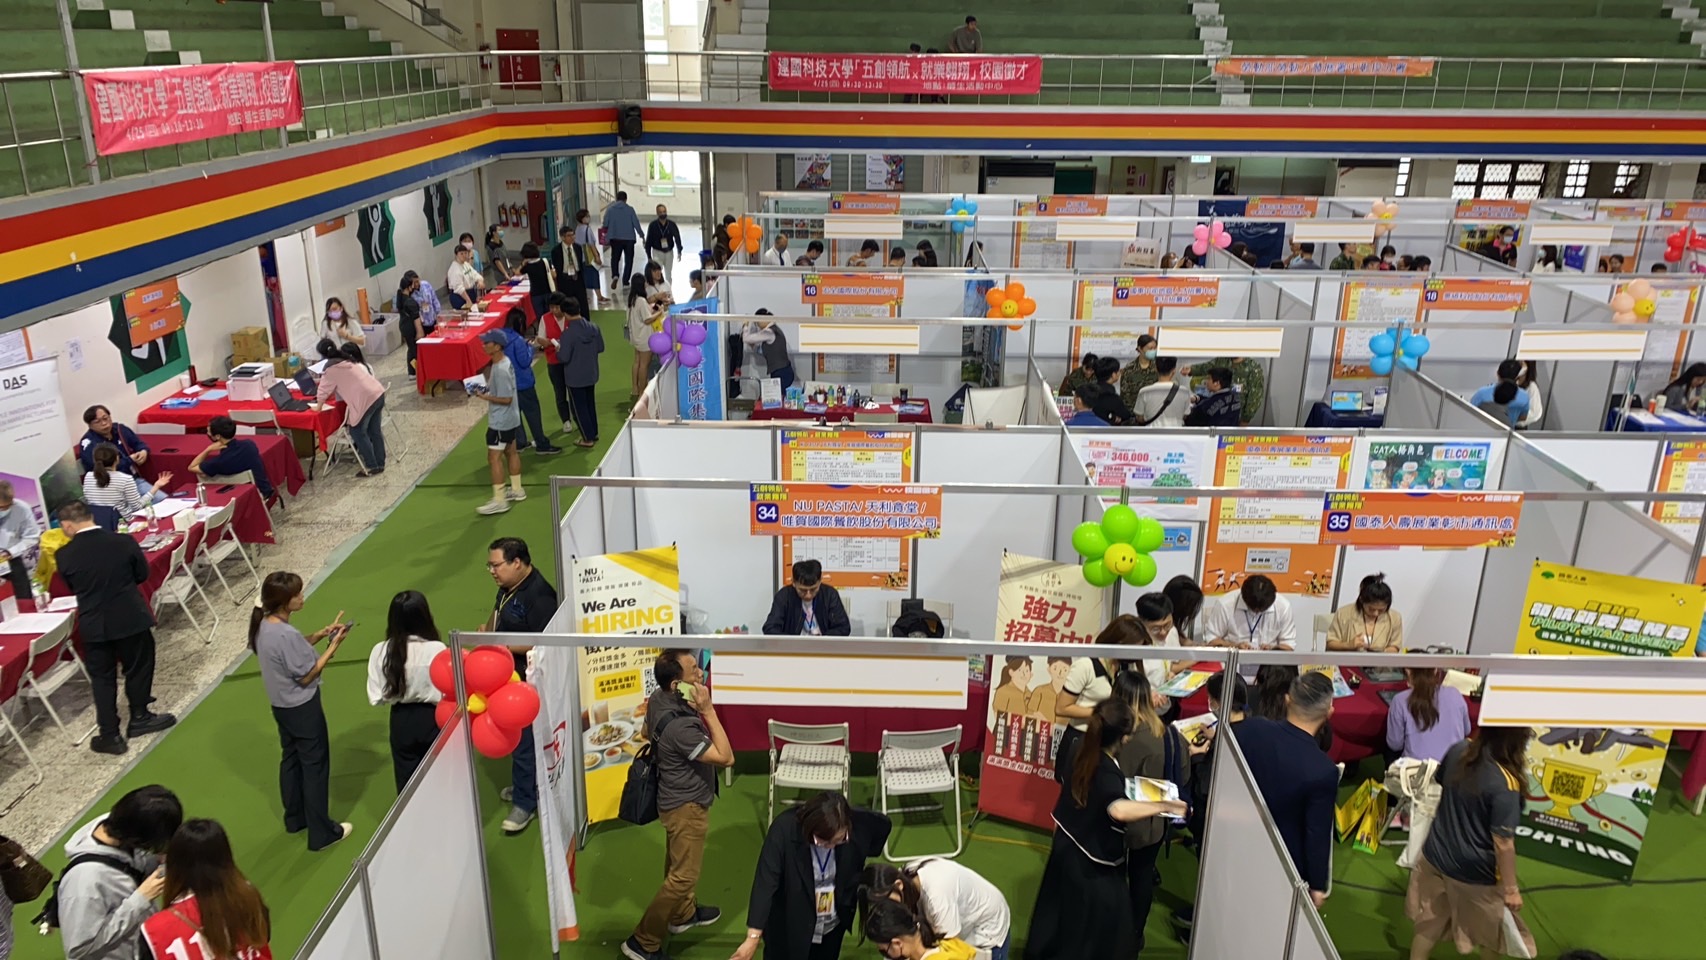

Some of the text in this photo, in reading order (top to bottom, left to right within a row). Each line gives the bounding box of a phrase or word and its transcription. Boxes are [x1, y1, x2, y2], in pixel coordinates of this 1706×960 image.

[805, 286, 816, 295] 16
[1117, 290, 1128, 299] 17
[1426, 292, 1437, 301] 18
[3, 375, 28, 390] DAS
[687, 363, 708, 420] 國際集
[1111, 452, 1150, 462] 346,000
[1435, 448, 1484, 459] WELCOME
[758, 506, 777, 520] 34
[793, 501, 812, 511] NU
[817, 501, 862, 512] PASTA/
[866, 501, 919, 514] 天利食堂
[781, 515, 937, 529] 唯賀國際餐飲股份有限公司
[1329, 514, 1349, 529] 35
[1354, 515, 1515, 531] 國泰人壽展業彰市通訊處
[584, 568, 598, 576] NU
[581, 597, 636, 614] We Are
[1022, 594, 1077, 627] 強力
[582, 604, 674, 634] HIRING
[1531, 617, 1580, 634] PILOT
[1581, 625, 1625, 642] STAR
[1626, 632, 1686, 652] AGENT
[591, 652, 627, 665] 分紅獎金多
[592, 661, 627, 673] 升遷速度快
[1515, 825, 1633, 866] GHTING
